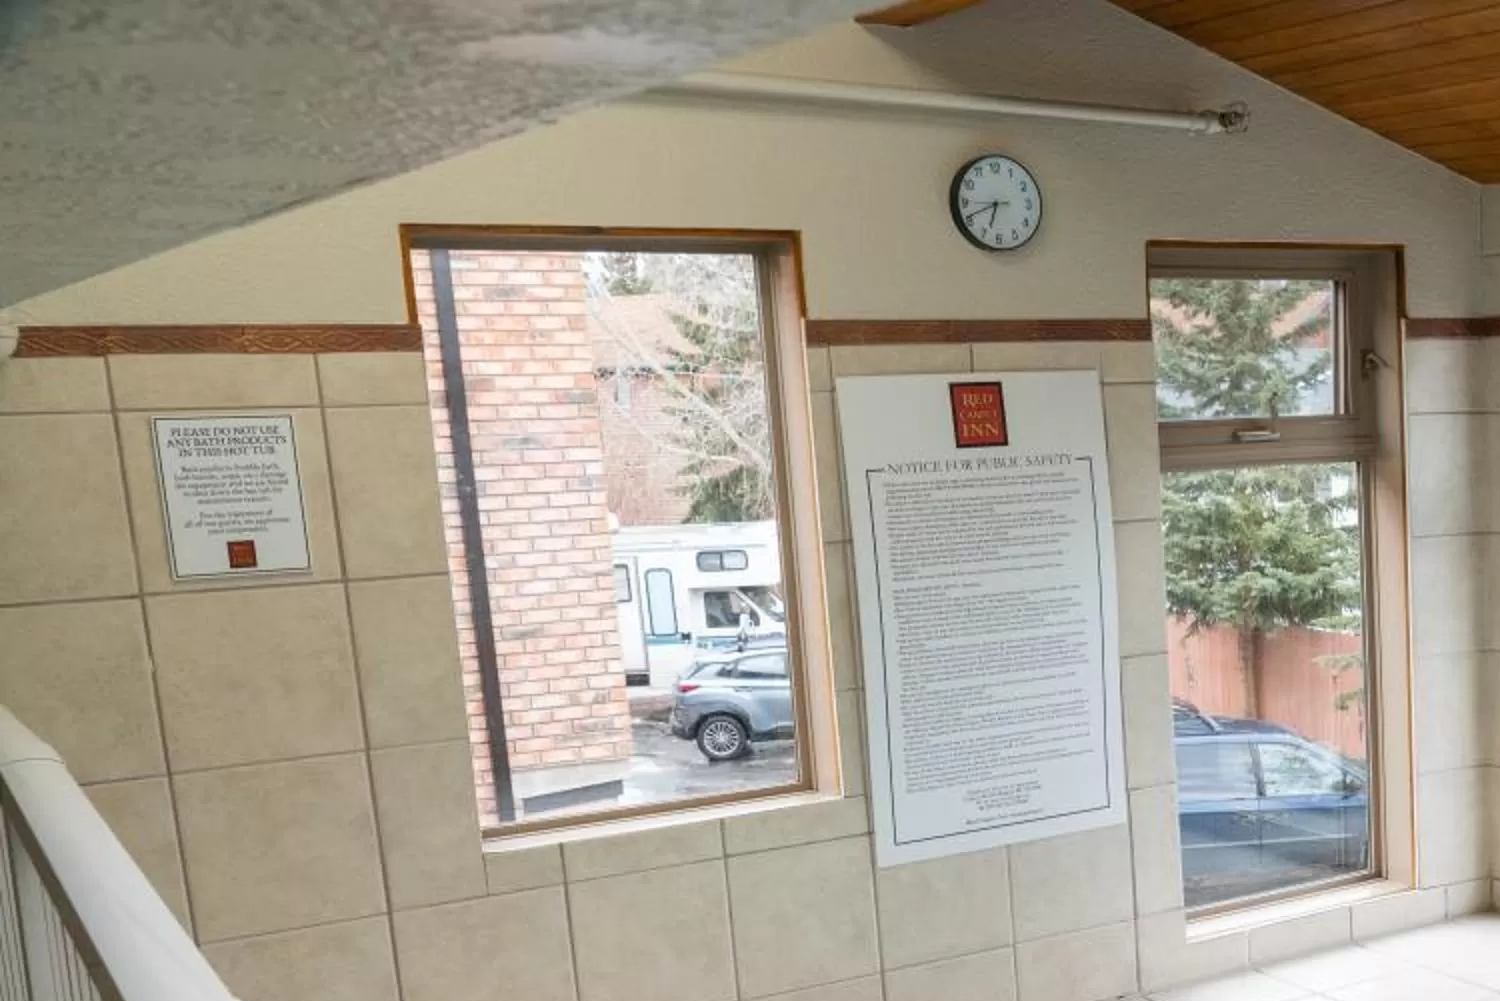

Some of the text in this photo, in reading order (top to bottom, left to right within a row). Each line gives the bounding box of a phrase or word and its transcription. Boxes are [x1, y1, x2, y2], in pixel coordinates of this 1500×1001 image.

[974, 167, 983, 177] 11
[1008, 167, 1013, 178] 1
[1019, 180, 1027, 192] 2
[995, 233, 1003, 245] 6
[961, 393, 993, 407] RED
[170, 424, 281, 437] PLEASE DO NOT USE
[962, 423, 999, 437] INN
[166, 435, 287, 449] ANY BATH PRODUCTS
[179, 447, 193, 458] IN
[224, 446, 249, 457] HOT
[253, 445, 276, 456] TUB
[886, 453, 1073, 475] NOTICE FOR PUBLIC SAFETY
